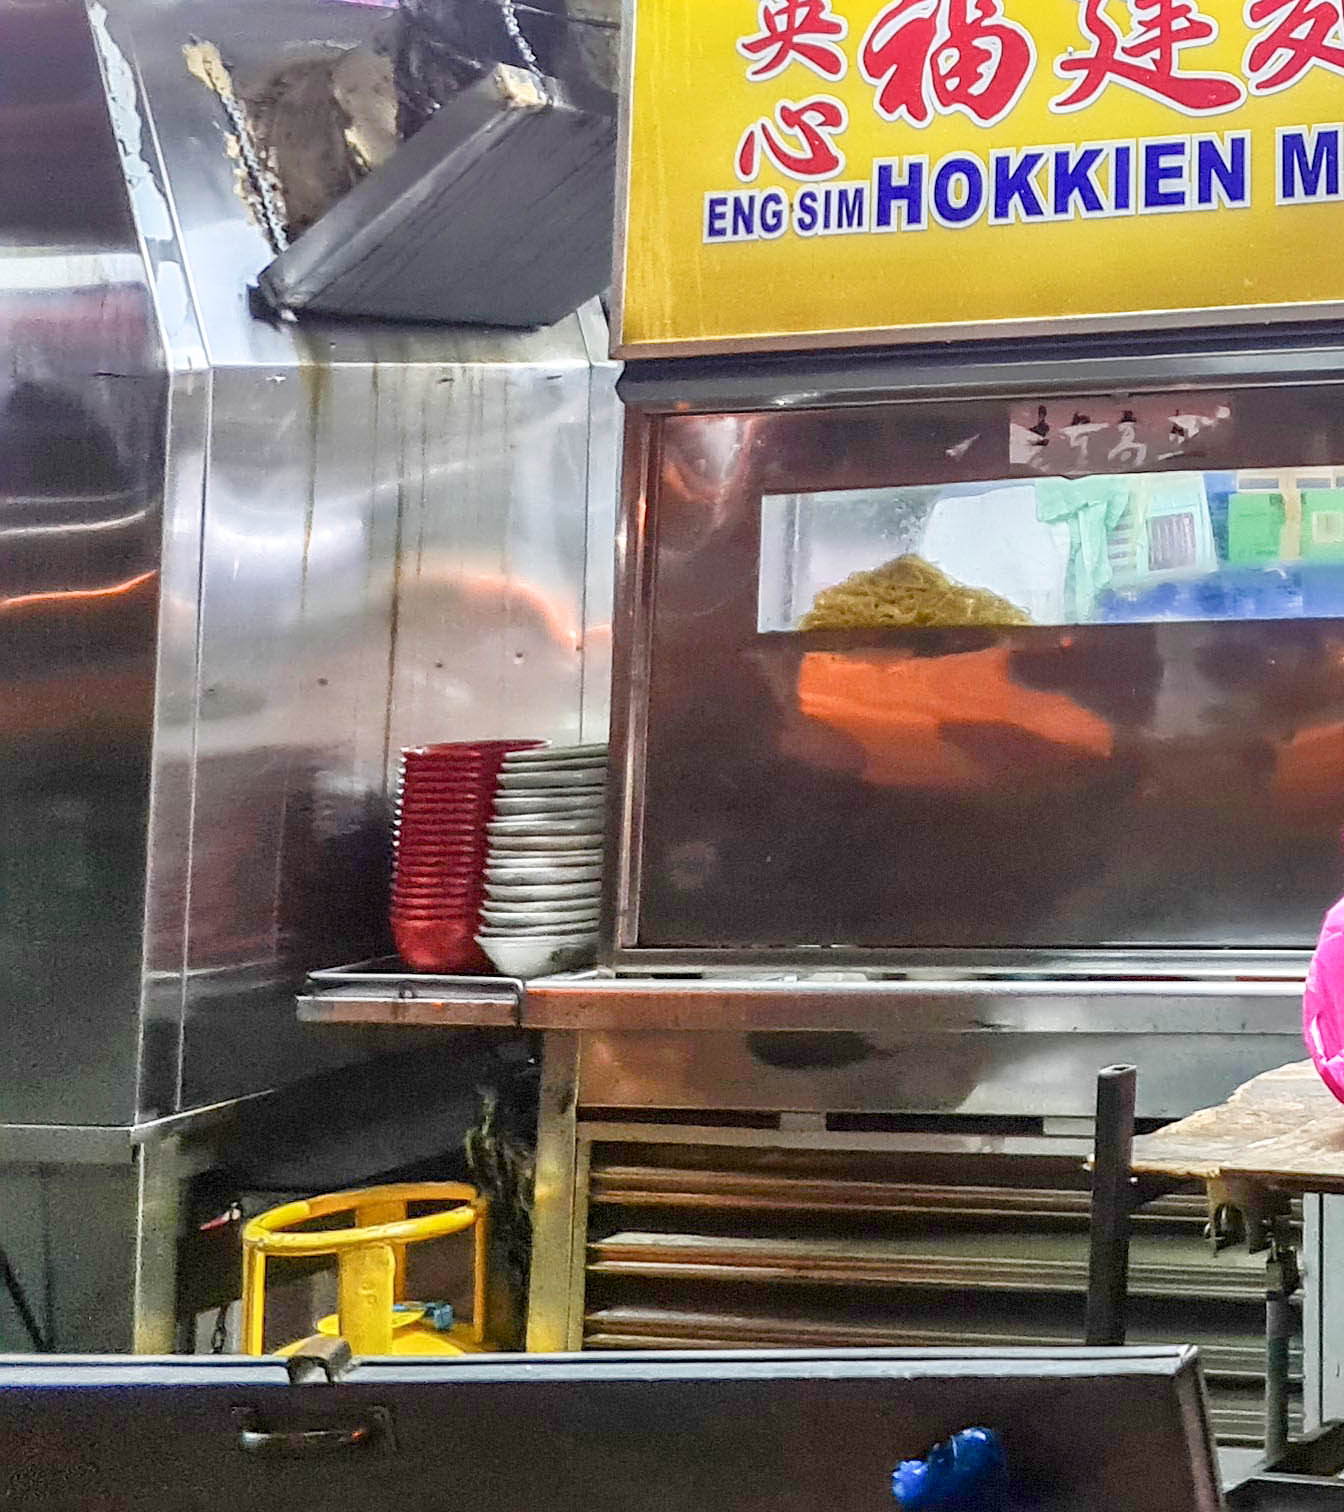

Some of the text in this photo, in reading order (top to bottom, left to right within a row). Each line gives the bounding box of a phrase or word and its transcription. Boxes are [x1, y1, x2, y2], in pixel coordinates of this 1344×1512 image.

[707, 192, 785, 240] ENG
[795, 187, 865, 233] SIM
[876, 136, 1247, 229] HOKKIEN
